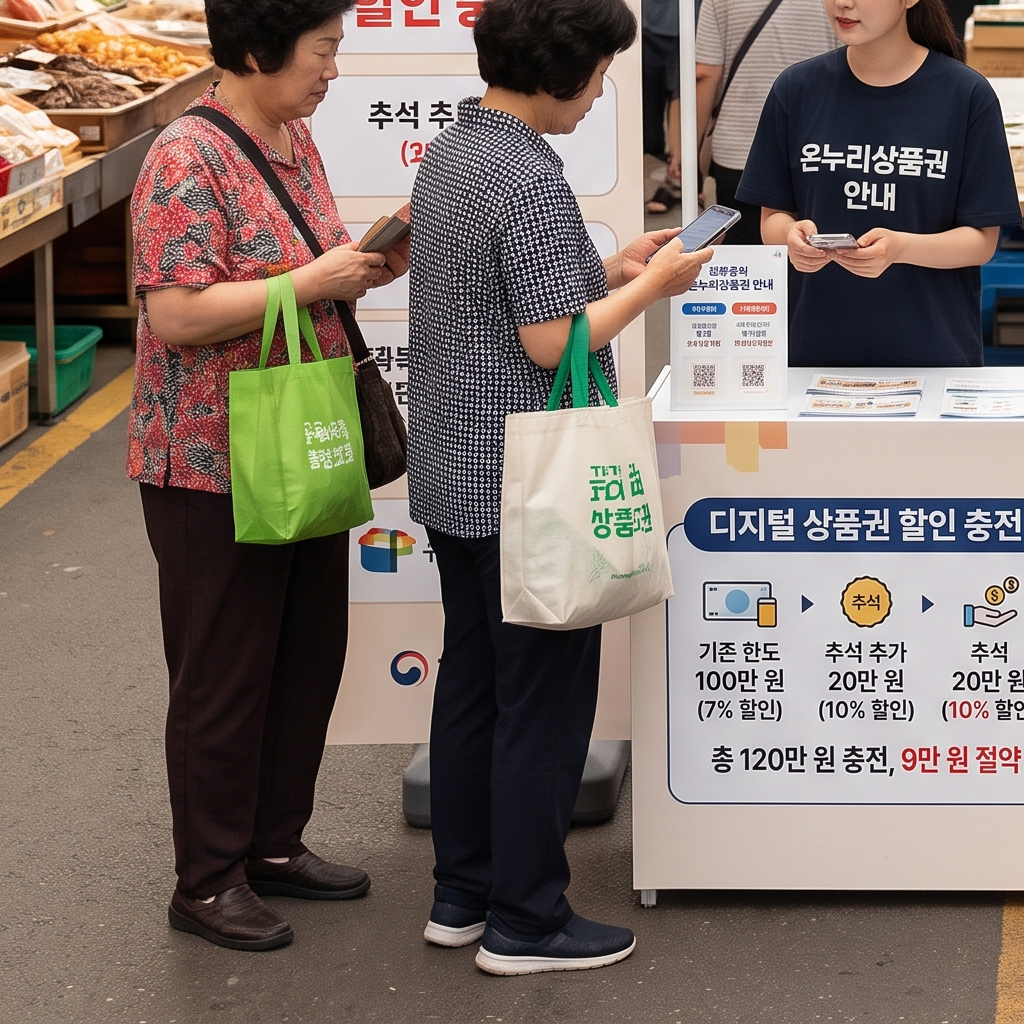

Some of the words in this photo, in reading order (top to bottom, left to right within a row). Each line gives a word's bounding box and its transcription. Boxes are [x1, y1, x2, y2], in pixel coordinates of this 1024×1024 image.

[367, 100, 420, 131] 추석
[800, 142, 950, 180] 온누리상품권
[843, 180, 897, 212] 안내
[752, 278, 775, 291] 안내
[709, 507, 796, 543] 디지털
[803, 507, 891, 543] 상품권
[899, 507, 957, 542] 할인
[963, 507, 1024, 542] 충전
[851, 593, 882, 612] 추석
[698, 641, 738, 663] 기존
[741, 641, 781, 663] 한도
[824, 641, 863, 664] 추석
[868, 641, 908, 664] 추가
[970, 641, 1009, 664] 추석
[694, 668, 758, 693] 100만
[763, 668, 785, 693] 원
[828, 669, 878, 693] 20만
[882, 669, 904, 693] 원
[951, 669, 1003, 693] 20만
[697, 699, 733, 723] (7%
[738, 699, 784, 723] 할인)
[818, 699, 866, 723] (10%
[871, 699, 916, 723] 할인)
[941, 699, 990, 723] (10%
[711, 745, 735, 774] 총
[739, 745, 808, 773] 120만
[813, 745, 836, 773] 원
[842, 745, 896, 776] 충전,
[900, 745, 941, 774] 9만
[946, 745, 970, 774] 원
[974, 745, 1023, 774] 절약
